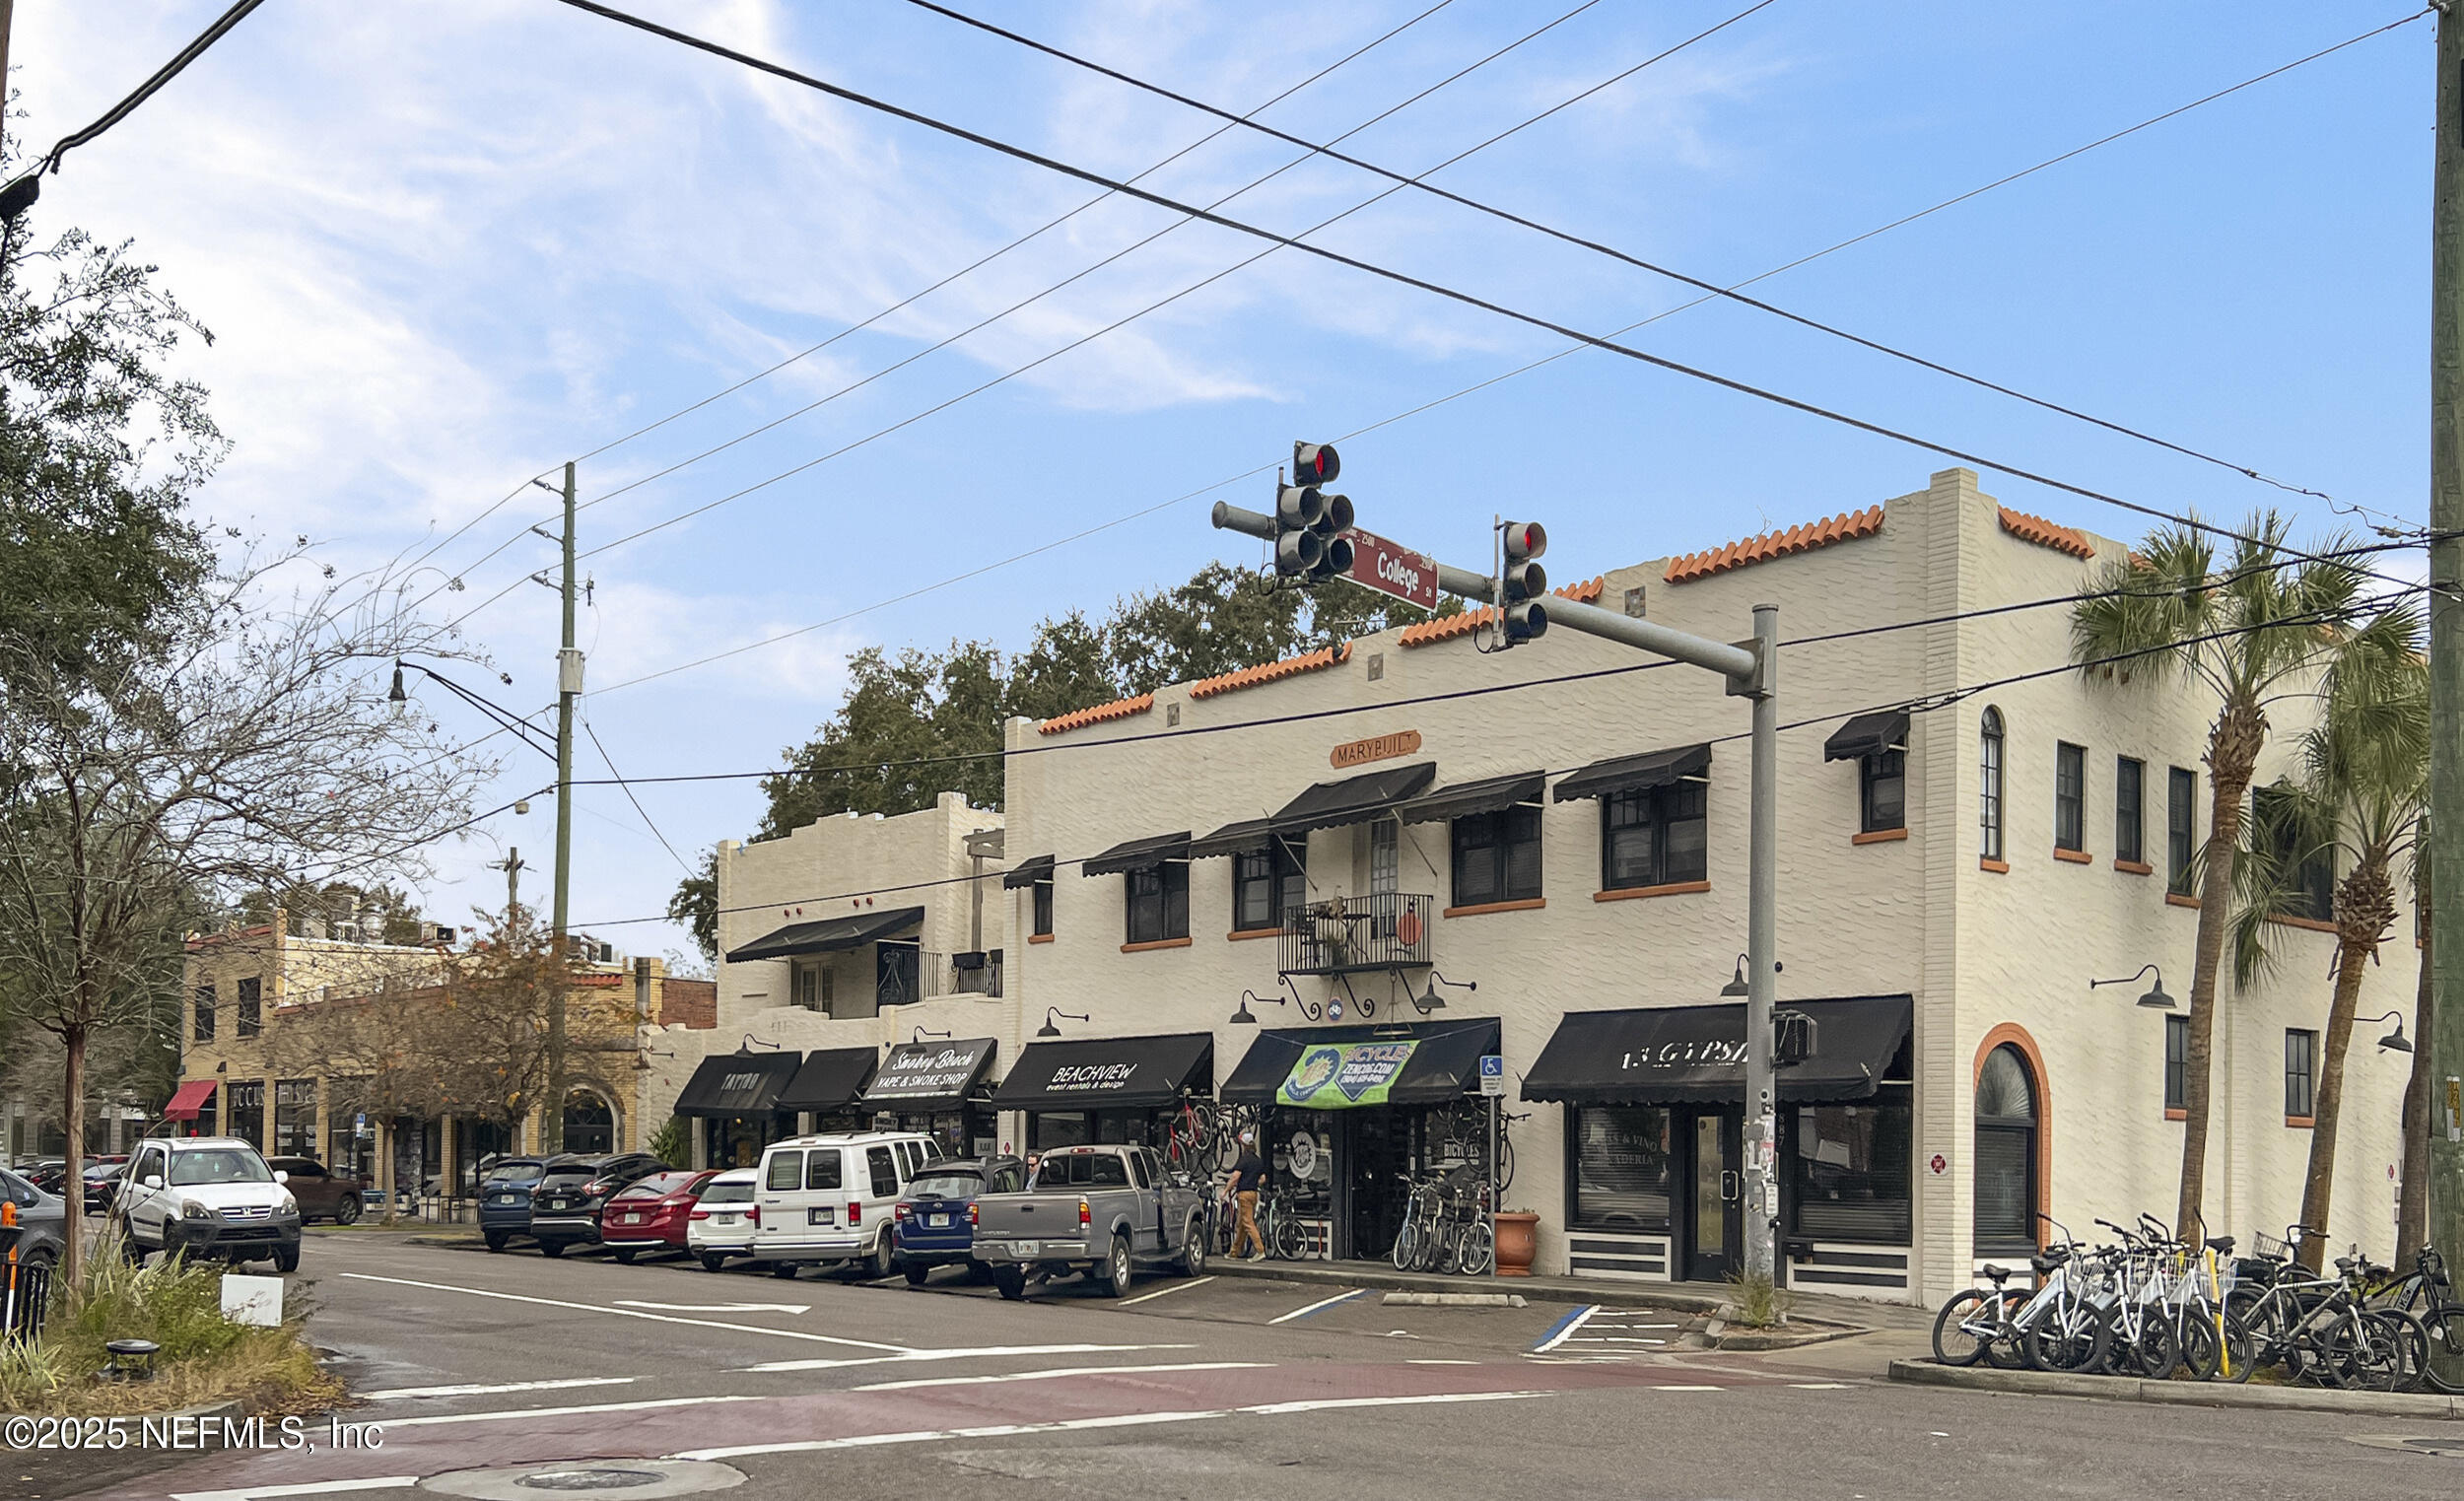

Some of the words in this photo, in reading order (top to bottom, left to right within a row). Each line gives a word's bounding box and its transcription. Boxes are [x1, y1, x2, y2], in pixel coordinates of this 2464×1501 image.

[1377, 551, 1419, 599] College
[1337, 733, 1412, 764] MARYBUILT
[934, 1049, 975, 1069] Beach
[876, 1076, 901, 1088] VAPE
[900, 1076, 909, 1088] &
[909, 1074, 941, 1087] SMOKE
[940, 1072, 968, 1085] SHOP
[1052, 1063, 1137, 1082] BEACHVIEW
